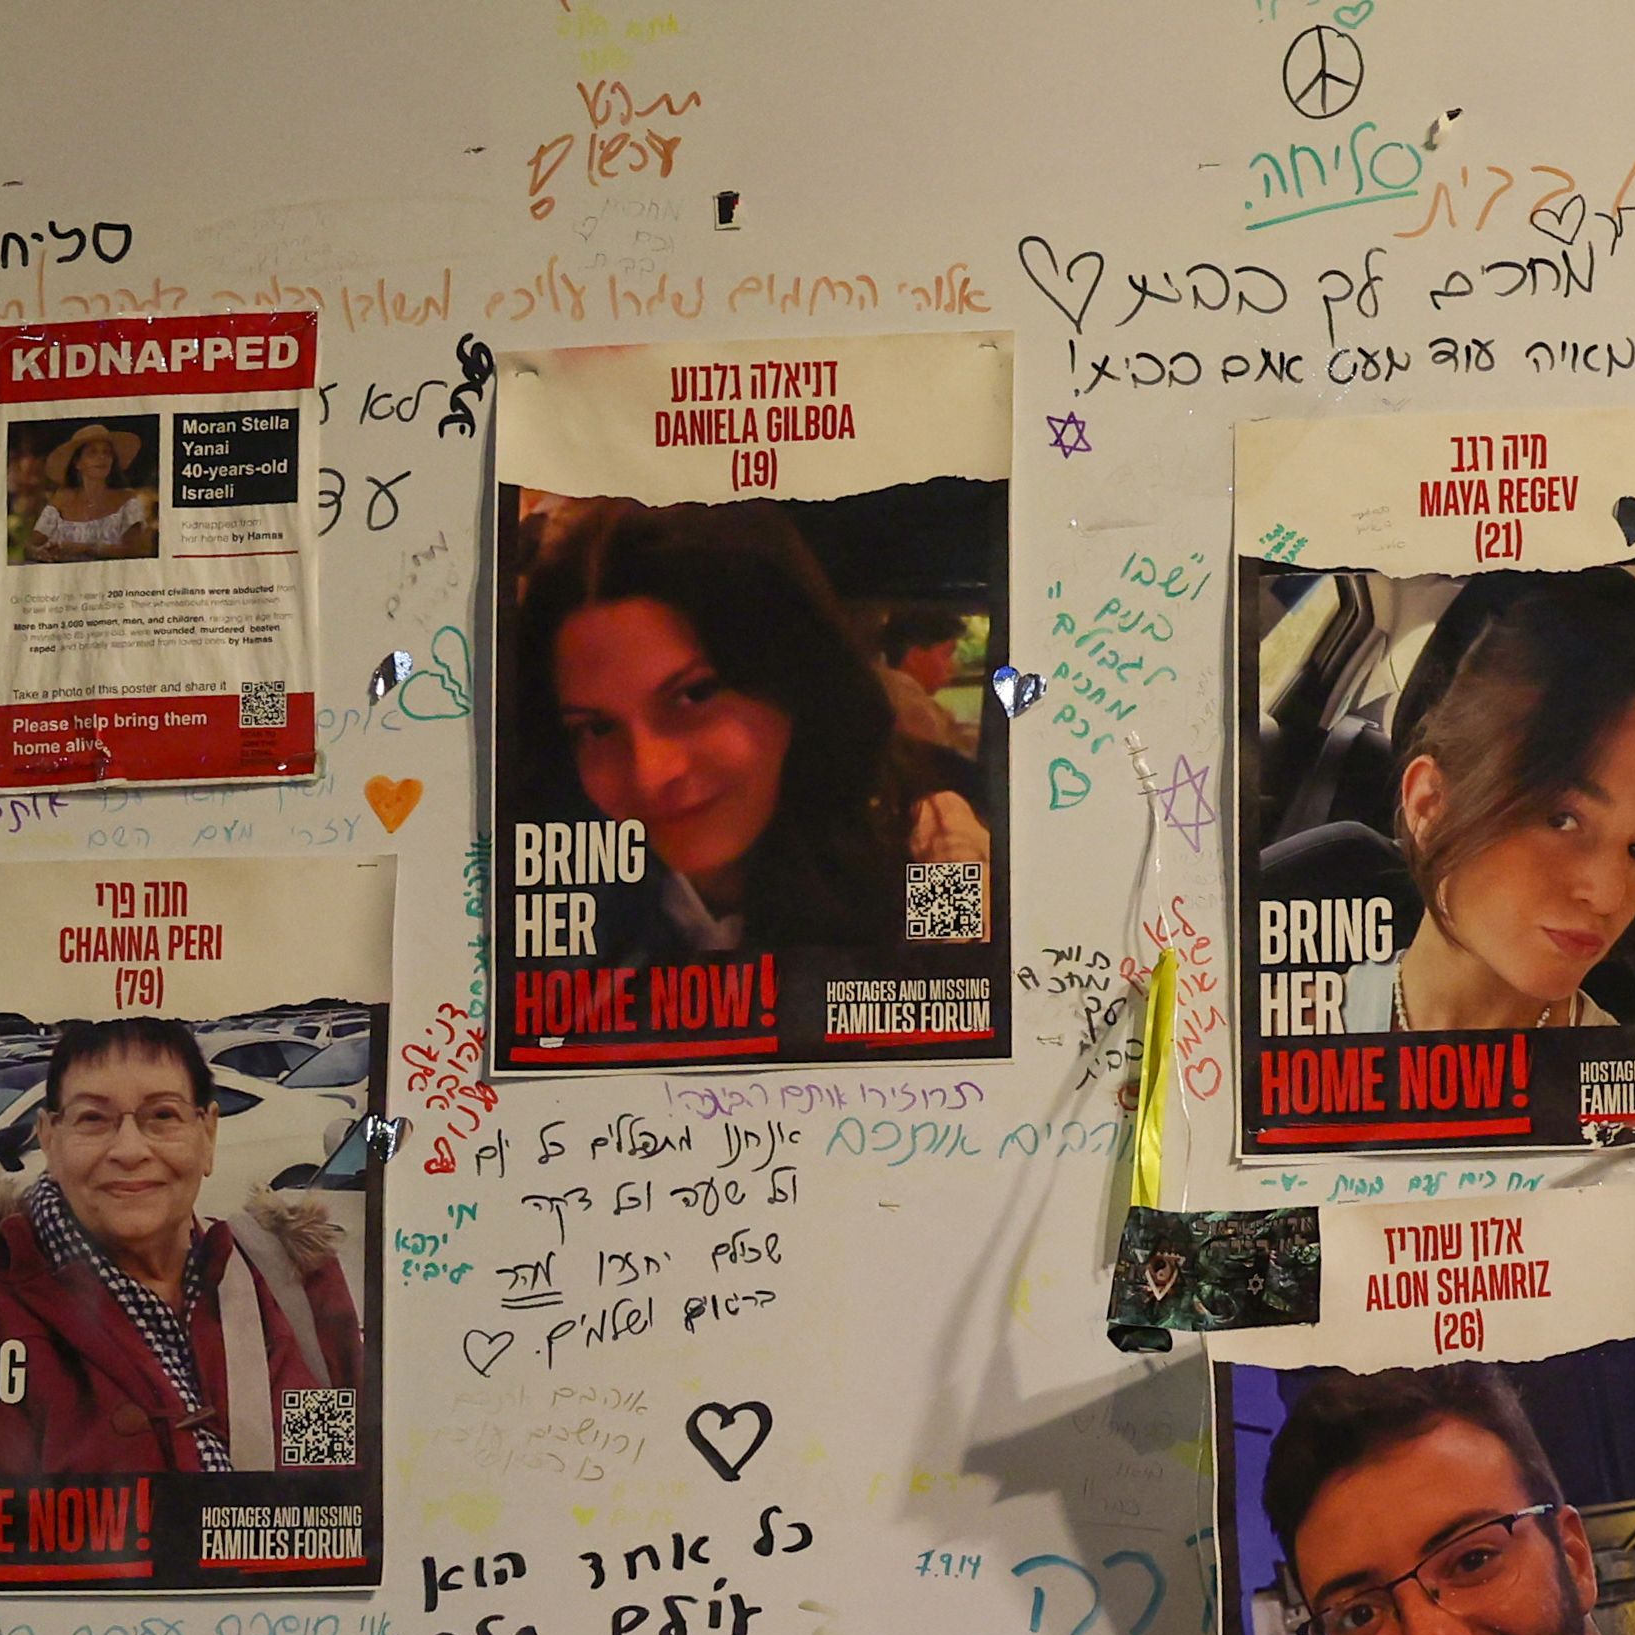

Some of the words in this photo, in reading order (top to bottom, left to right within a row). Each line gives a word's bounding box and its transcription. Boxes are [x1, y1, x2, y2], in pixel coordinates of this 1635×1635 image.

[12, 335, 300, 381] KIDNAPPED
[672, 363, 741, 402] גלבוע
[751, 361, 837, 399] דניאלה
[182, 419, 237, 434] Moran
[241, 415, 290, 432] Stella
[656, 408, 758, 447] DANIELA
[767, 404, 855, 442] GILBOA
[182, 440, 230, 456] Yanai
[1452, 436, 1493, 472] רגב
[1503, 434, 1546, 470] מיה
[181, 459, 288, 481] 40-years-old
[732, 448, 777, 490] (19)
[182, 483, 235, 500] Israeli
[1421, 480, 1490, 517] MAYA
[1499, 476, 1578, 513] REGEV
[247, 531, 284, 541] Hamas
[1476, 520, 1522, 560] (21)
[13, 688, 40, 700] Take
[52, 686, 83, 700] photo
[85, 684, 97, 696] of
[98, 683, 118, 695] this
[121, 684, 157, 698] poster
[160, 682, 182, 693] and
[184, 681, 217, 693] share
[219, 680, 227, 692] it
[13, 717, 69, 733] Please
[73, 714, 109, 731] help
[114, 711, 160, 731] bring
[164, 711, 208, 727] them
[13, 739, 61, 756] home
[516, 819, 645, 886] BRING
[96, 883, 135, 918] פרי
[145, 881, 187, 917] חנה
[60, 926, 159, 963] CHANNA
[169, 925, 222, 960] PERI
[516, 893, 596, 957] HER
[116, 968, 163, 1008] (79)
[515, 968, 637, 1035] HOME
[651, 954, 777, 1029] NOW!
[1384, 1223, 1462, 1264] שמריז
[1471, 1217, 1524, 1262] אלון
[1367, 1270, 1428, 1312] ALON
[1437, 1261, 1551, 1305] SHAMRIZ
[1435, 1309, 1484, 1354] (26)
[753, 1506, 812, 1556] כל
[579, 1533, 710, 1589] אחד
[422, 1552, 526, 1612] הוא
